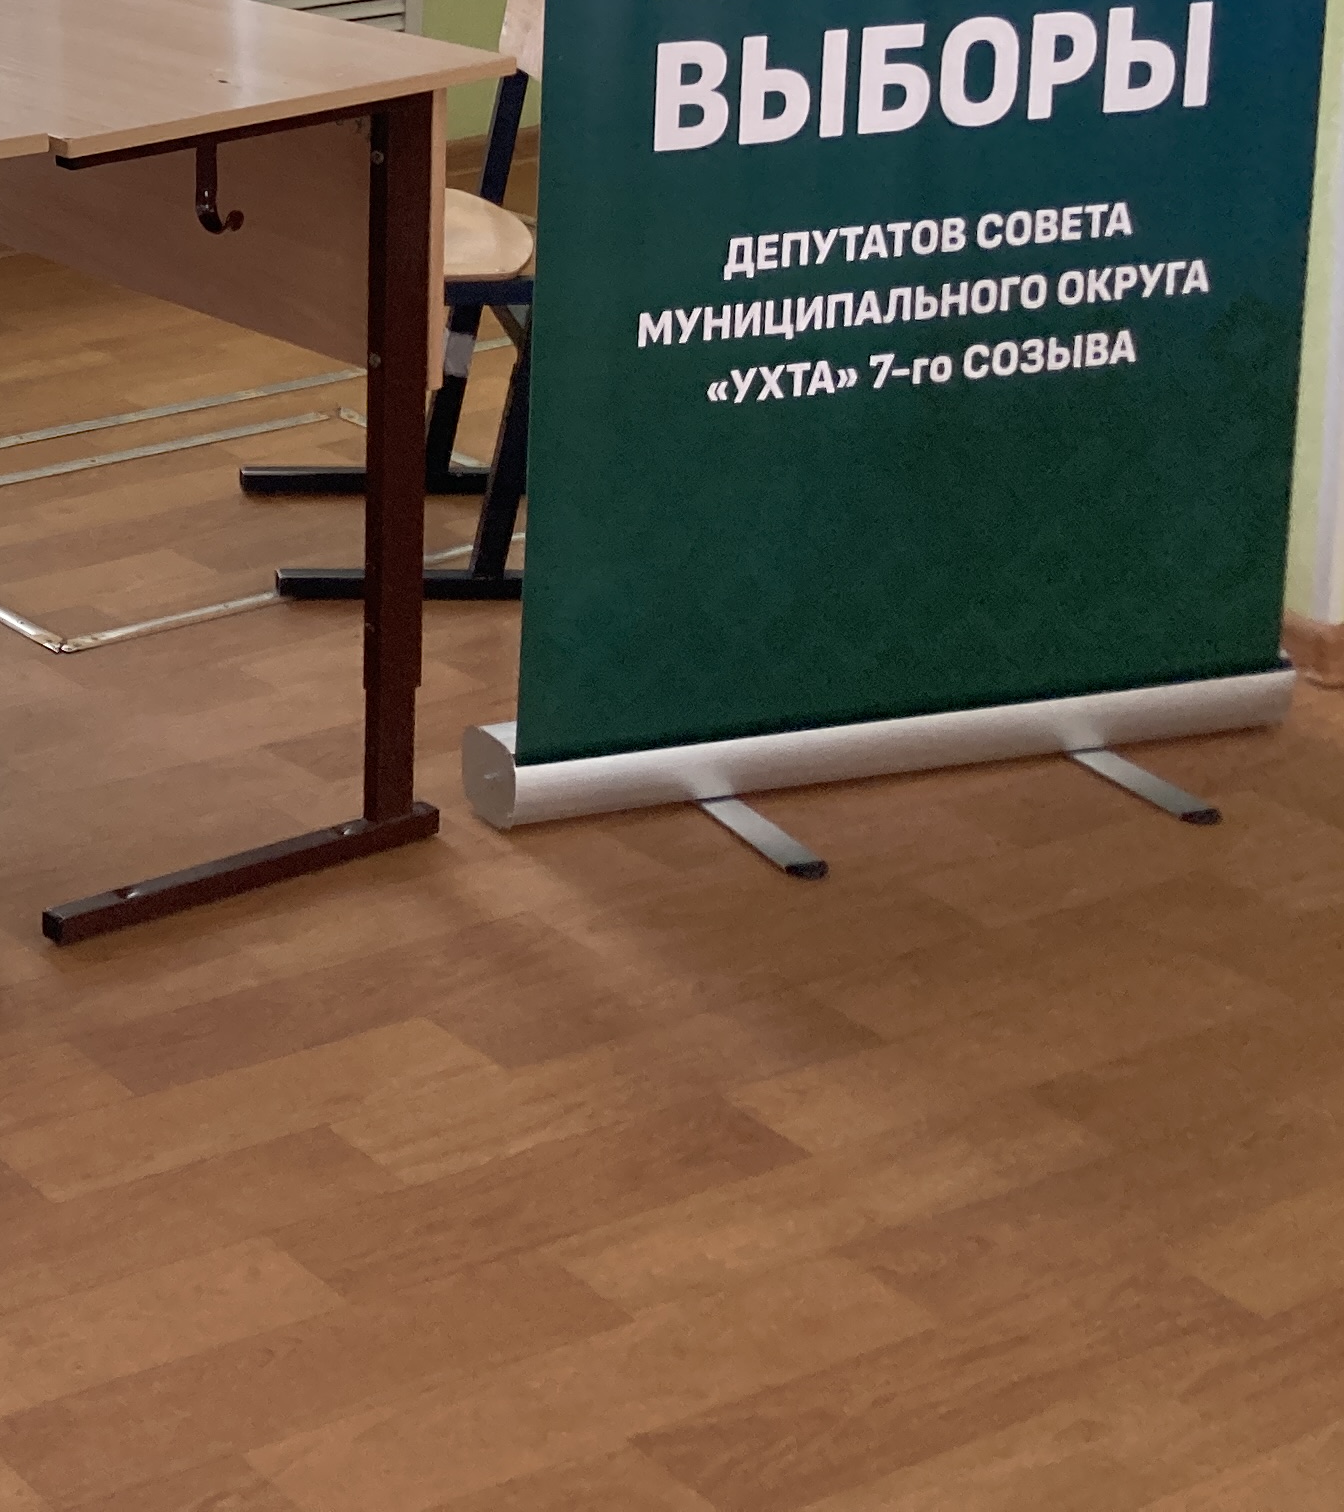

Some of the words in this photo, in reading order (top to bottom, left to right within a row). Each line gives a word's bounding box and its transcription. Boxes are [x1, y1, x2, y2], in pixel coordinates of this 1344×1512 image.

[653, 0, 1214, 153] ВЫБОРЫ
[722, 217, 967, 281] ДЕПУТАТОВ
[975, 201, 1133, 250] СОВЕТА
[637, 273, 1049, 348] МУНИЦИПАЛЬНОГО
[1055, 258, 1210, 307] ОКРУГА
[706, 358, 858, 405] «УХТА»
[868, 352, 953, 390] 7-го
[962, 329, 1137, 380] СОЗЫВА
